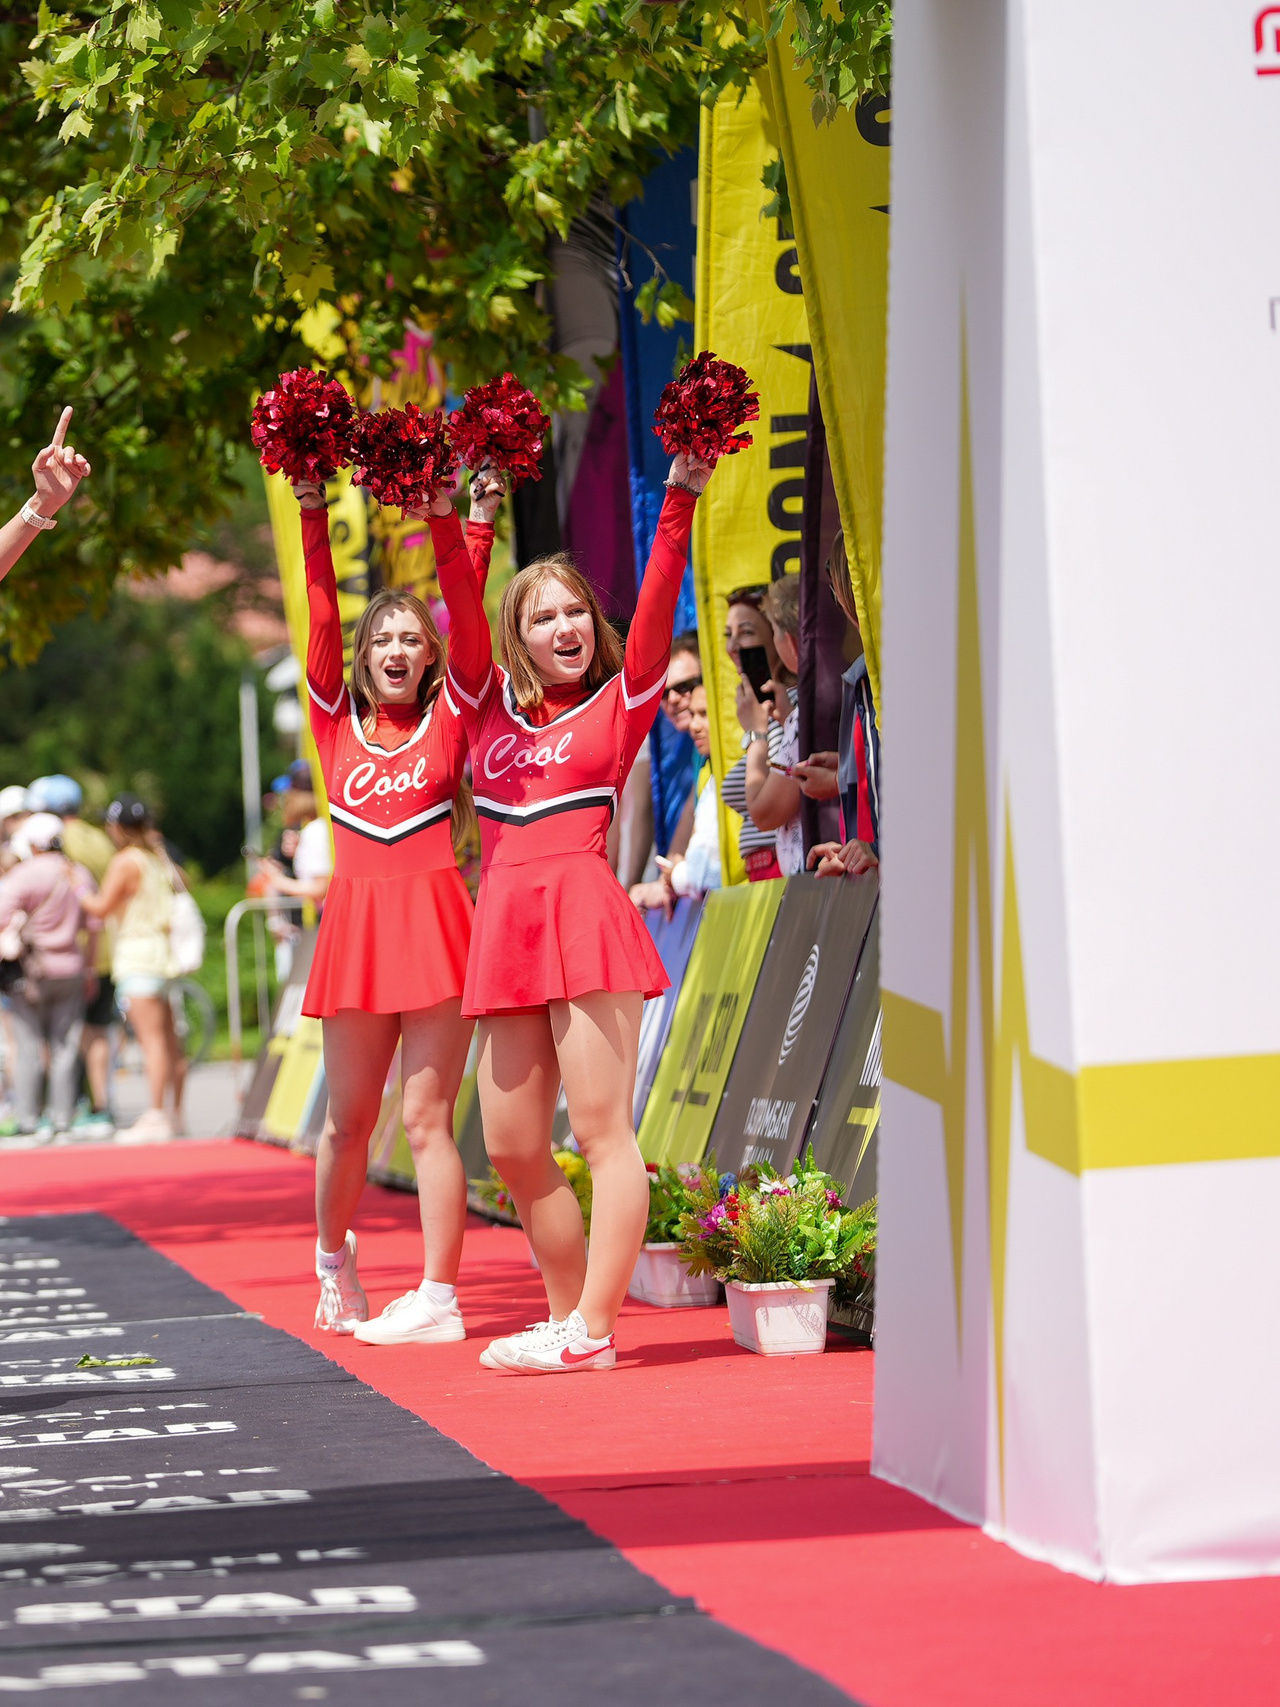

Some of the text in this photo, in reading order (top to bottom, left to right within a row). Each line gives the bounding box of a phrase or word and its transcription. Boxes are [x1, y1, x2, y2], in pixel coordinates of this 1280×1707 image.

[484, 731, 573, 780] Cool
[343, 757, 428, 807] Cool
[15, 1585, 418, 1623] STAR
[39, 1640, 487, 1677] STAR
